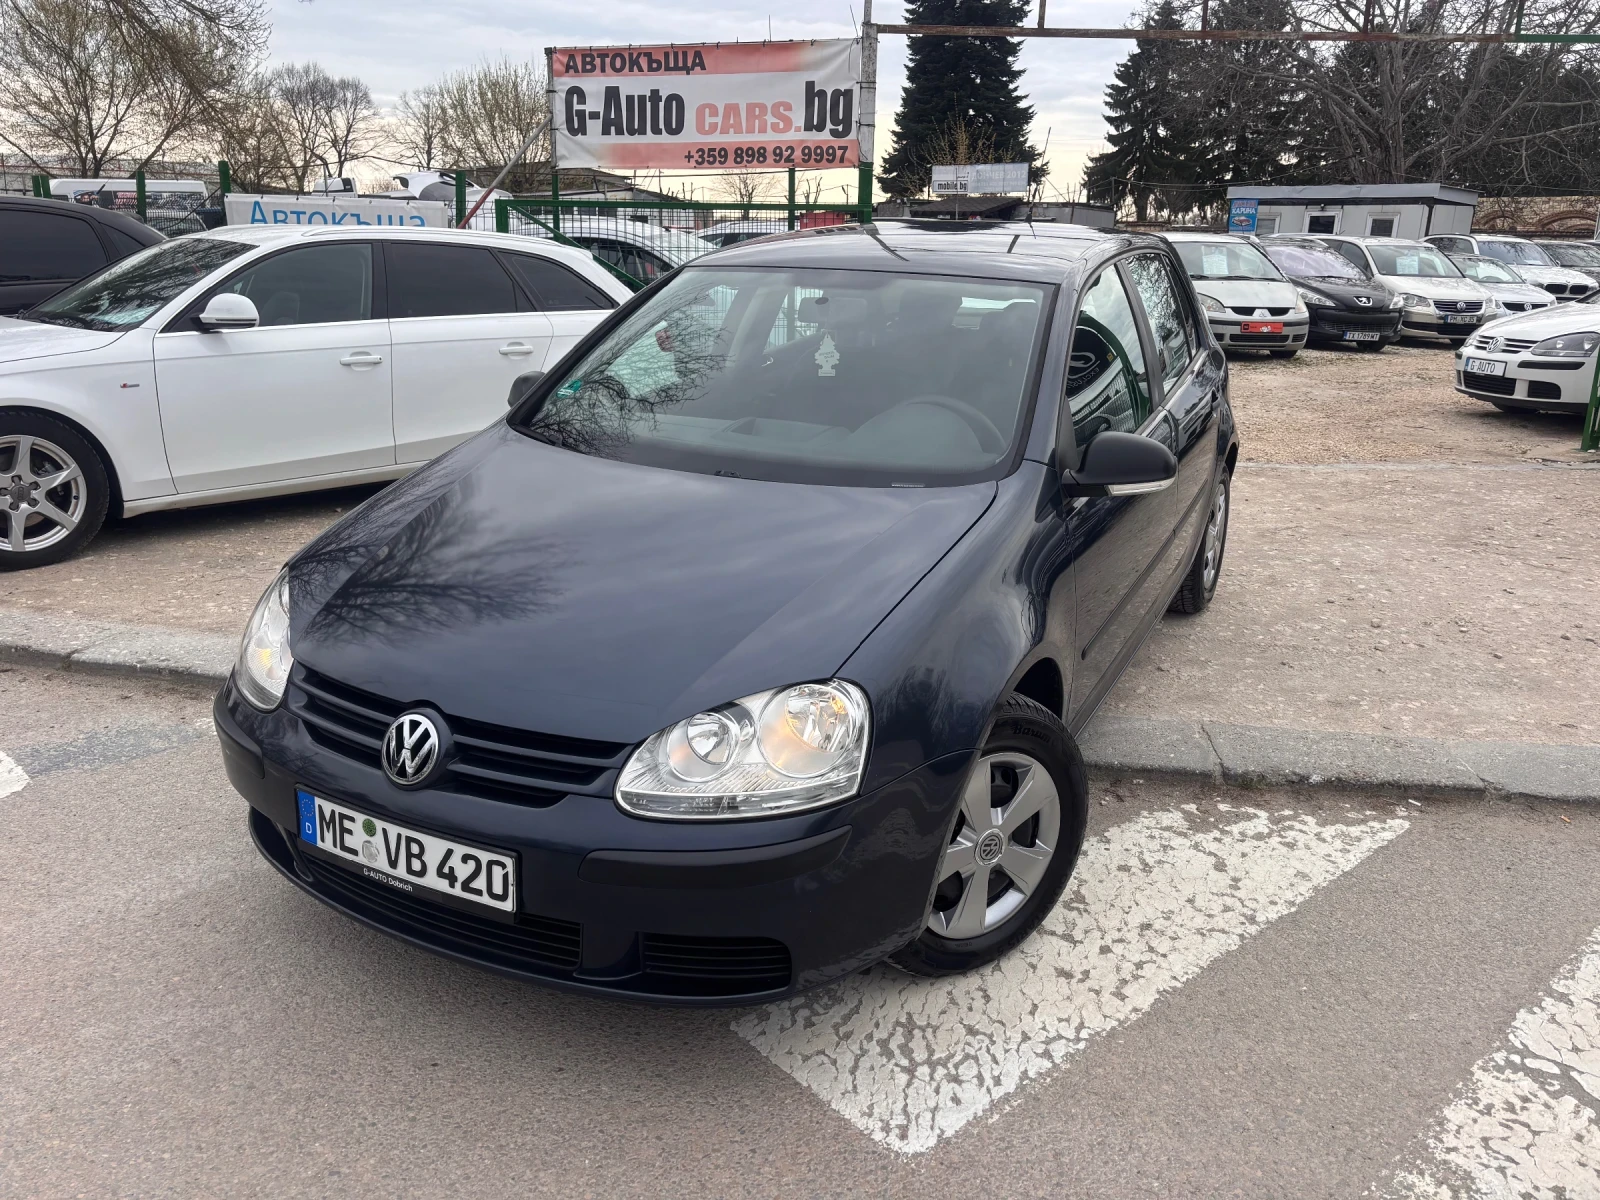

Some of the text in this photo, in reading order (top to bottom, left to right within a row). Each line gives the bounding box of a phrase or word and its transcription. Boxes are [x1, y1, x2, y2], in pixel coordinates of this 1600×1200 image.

[564, 50, 707, 75] АВТОКЪЩА
[564, 85, 686, 137] G-Auto
[684, 145, 849, 166] +359 898 92 9997
[1007, 170, 1027, 179] 2012
[937, 182, 967, 192] mobilebg
[305, 822, 313, 835] D
[317, 803, 510, 903] ME VB 420
[363, 867, 413, 892] G-AUTO Dobrich
